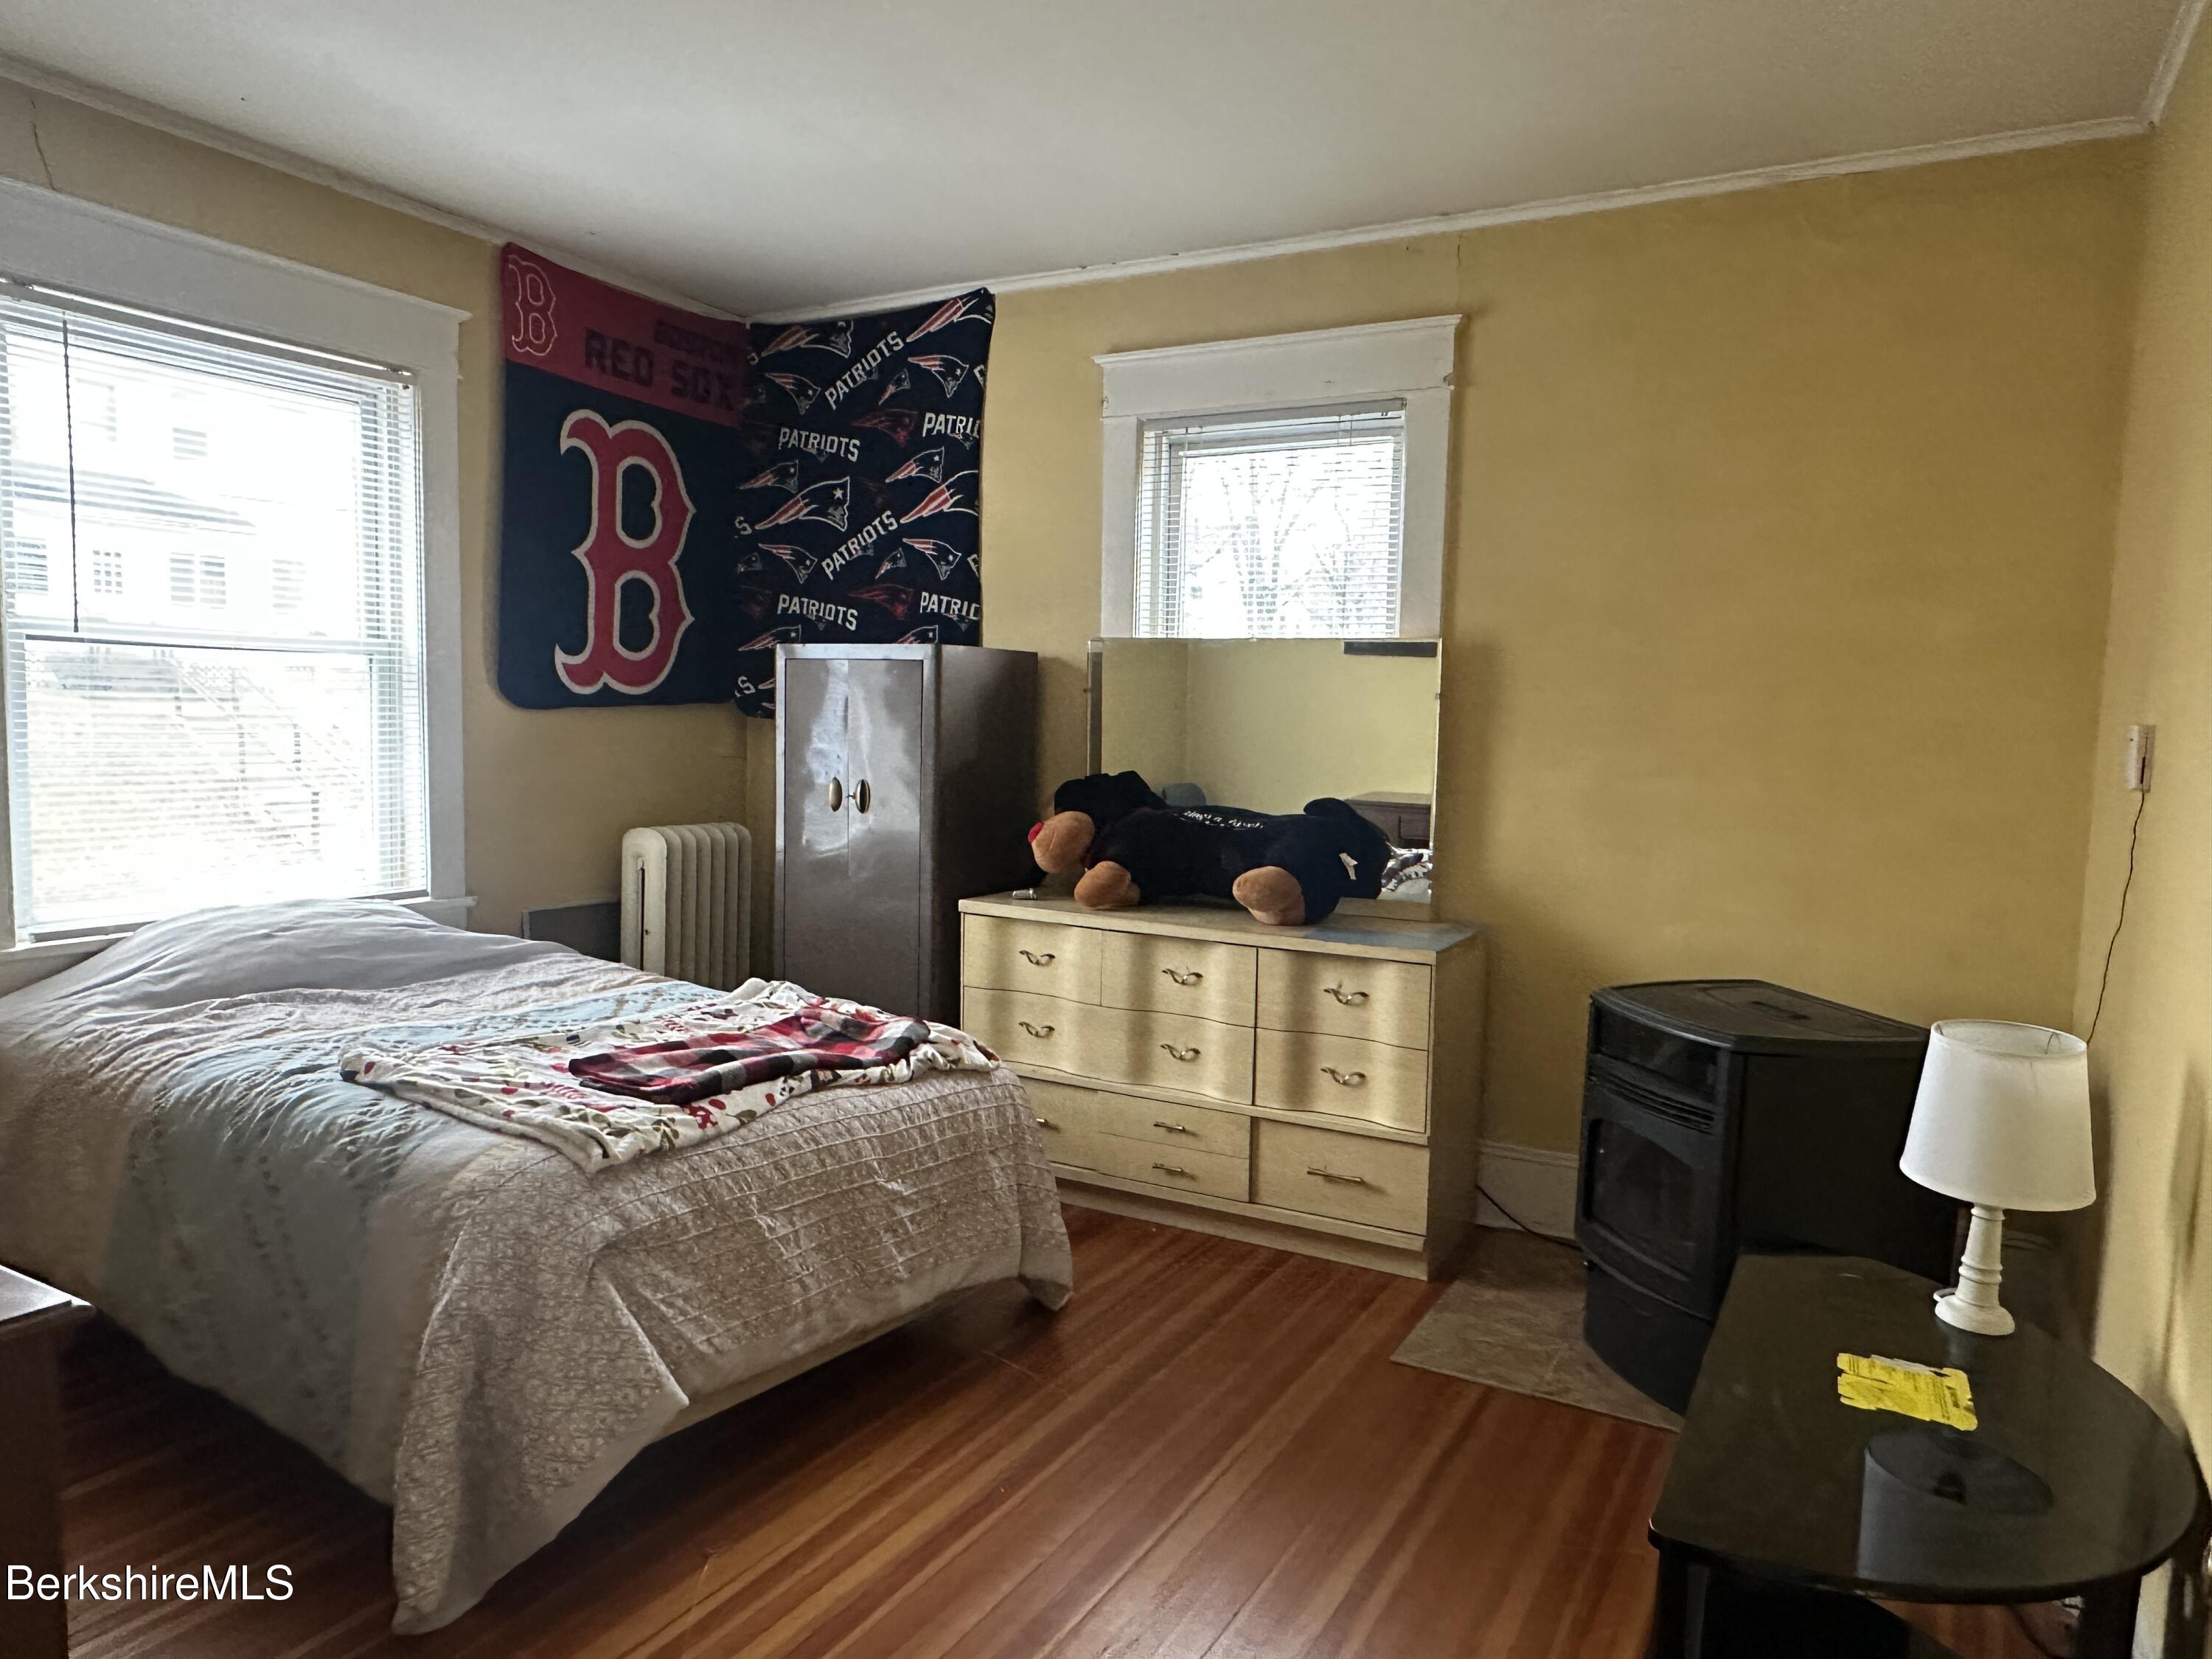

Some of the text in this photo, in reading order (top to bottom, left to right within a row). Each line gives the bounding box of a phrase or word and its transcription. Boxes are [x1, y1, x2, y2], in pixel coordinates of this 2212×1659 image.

[508, 254, 557, 356] B
[585, 327, 654, 387] RED
[824, 331, 905, 411] PATRIOTS
[779, 426, 860, 462] PATRIOTS
[554, 408, 697, 695] B
[821, 510, 899, 581] PATRIOTS
[776, 594, 858, 631] PATRIOTS
